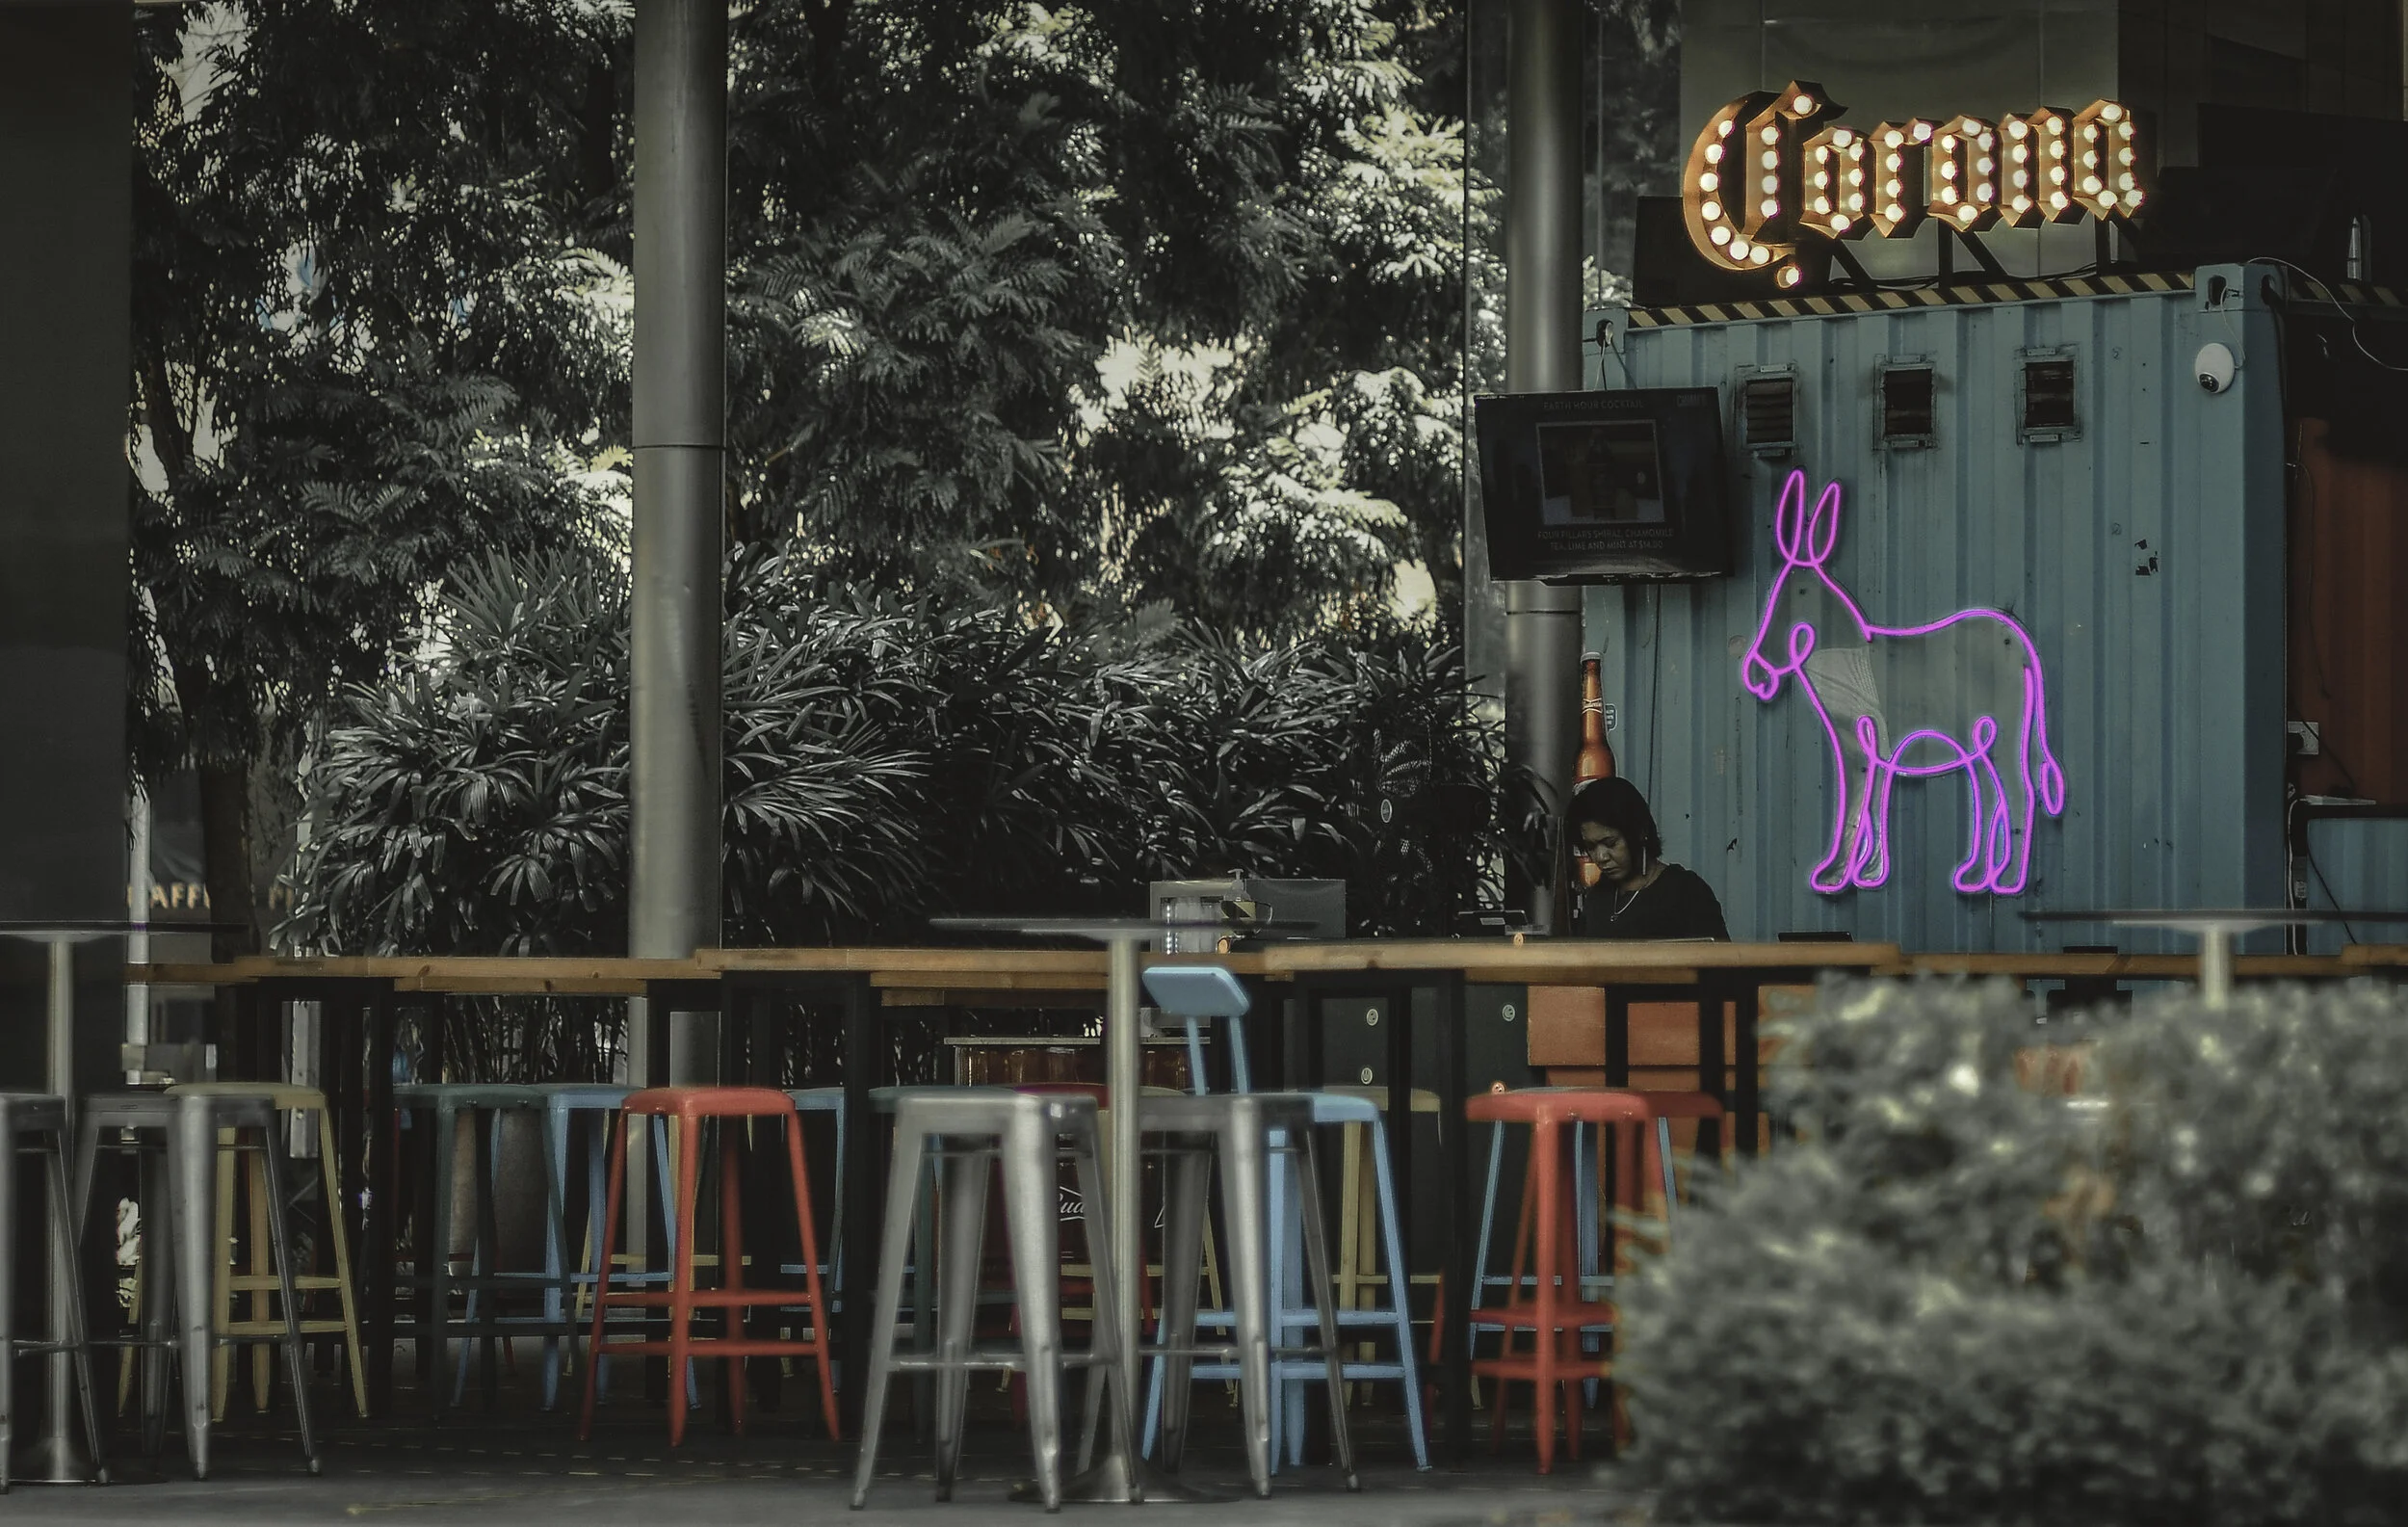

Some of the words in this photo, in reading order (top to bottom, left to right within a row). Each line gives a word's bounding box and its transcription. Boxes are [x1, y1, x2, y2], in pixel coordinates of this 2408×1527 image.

[1683, 80, 2145, 288] Corona
[1543, 401, 1571, 409] EARTH
[1573, 400, 1599, 409] HOUR
[1601, 399, 1644, 408] COCKTAIL
[1625, 528, 1675, 538] CHAMOMILE
[1568, 541, 1586, 550] LIME
[1587, 540, 1606, 550] AND
[127, 882, 211, 910] AFF
